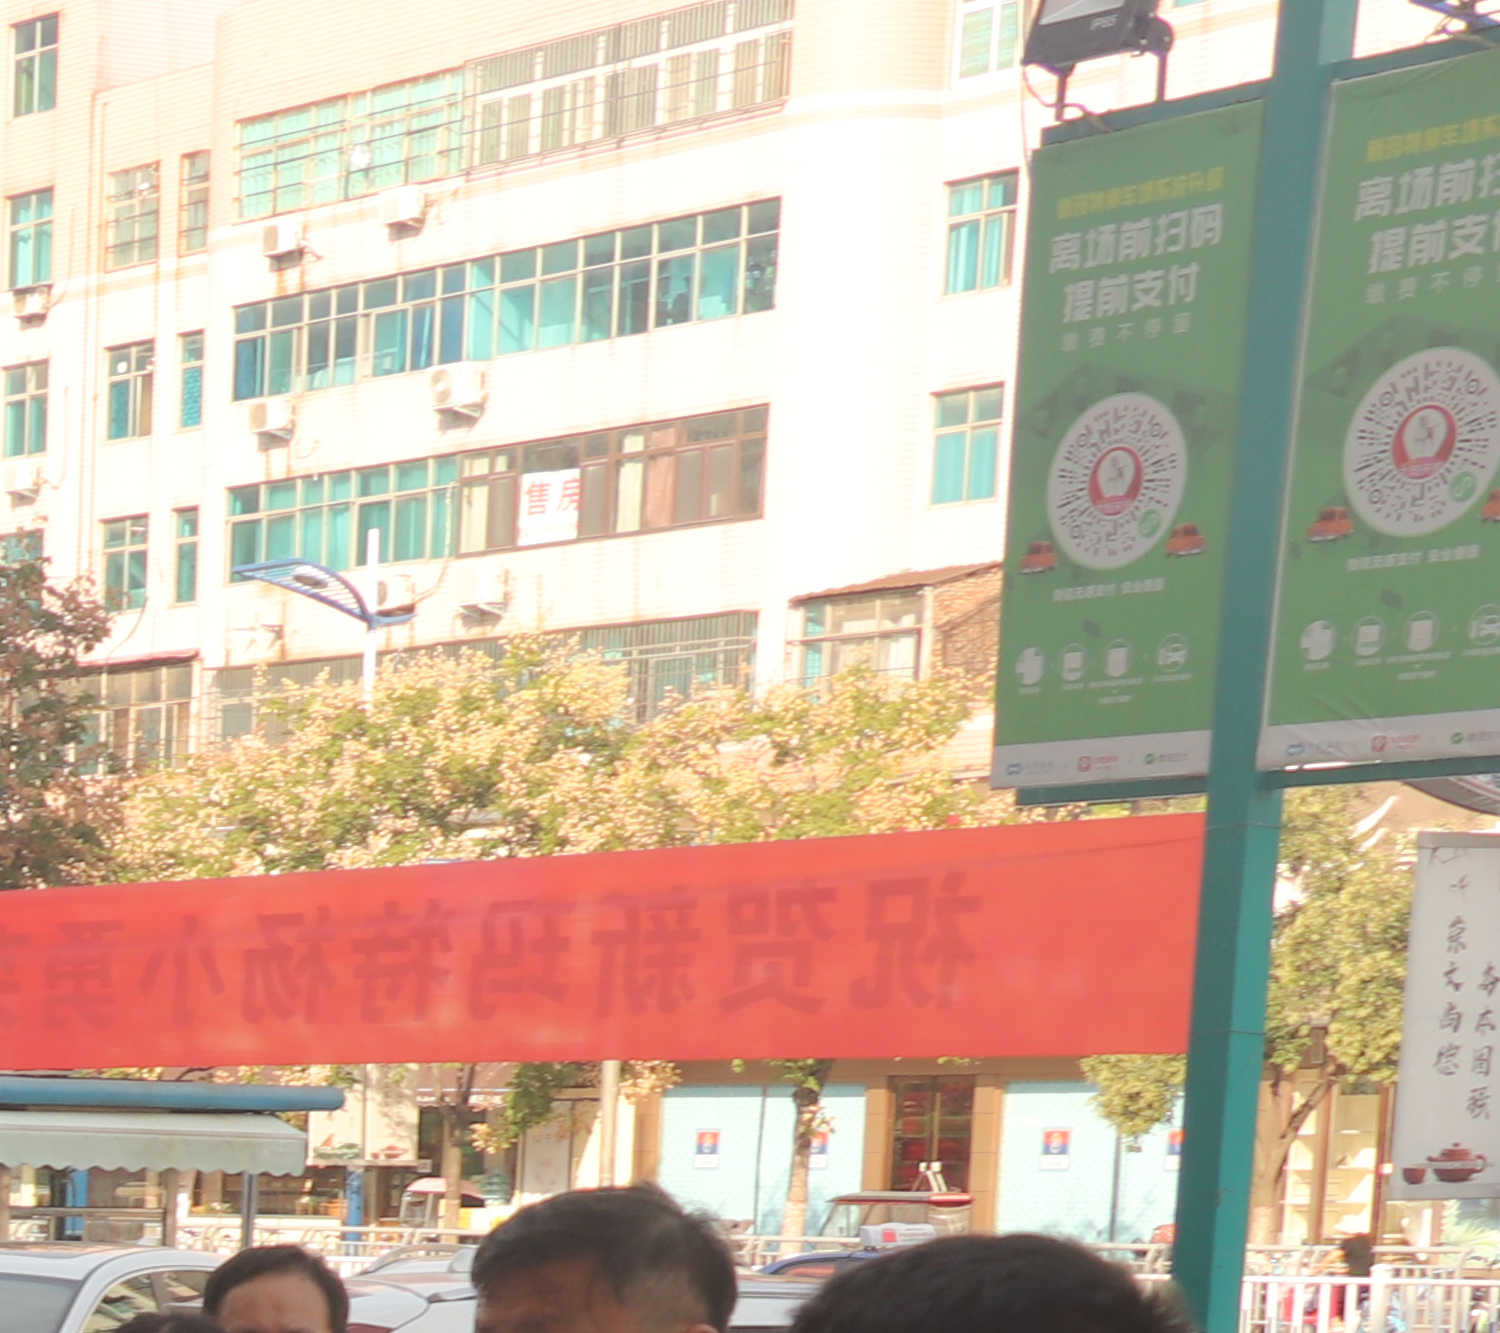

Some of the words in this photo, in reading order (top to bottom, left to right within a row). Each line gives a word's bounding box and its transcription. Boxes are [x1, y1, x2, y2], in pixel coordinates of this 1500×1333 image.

[1049, 203, 1224, 274] 离场前扫码
[1062, 261, 1199, 323] 提前支付
